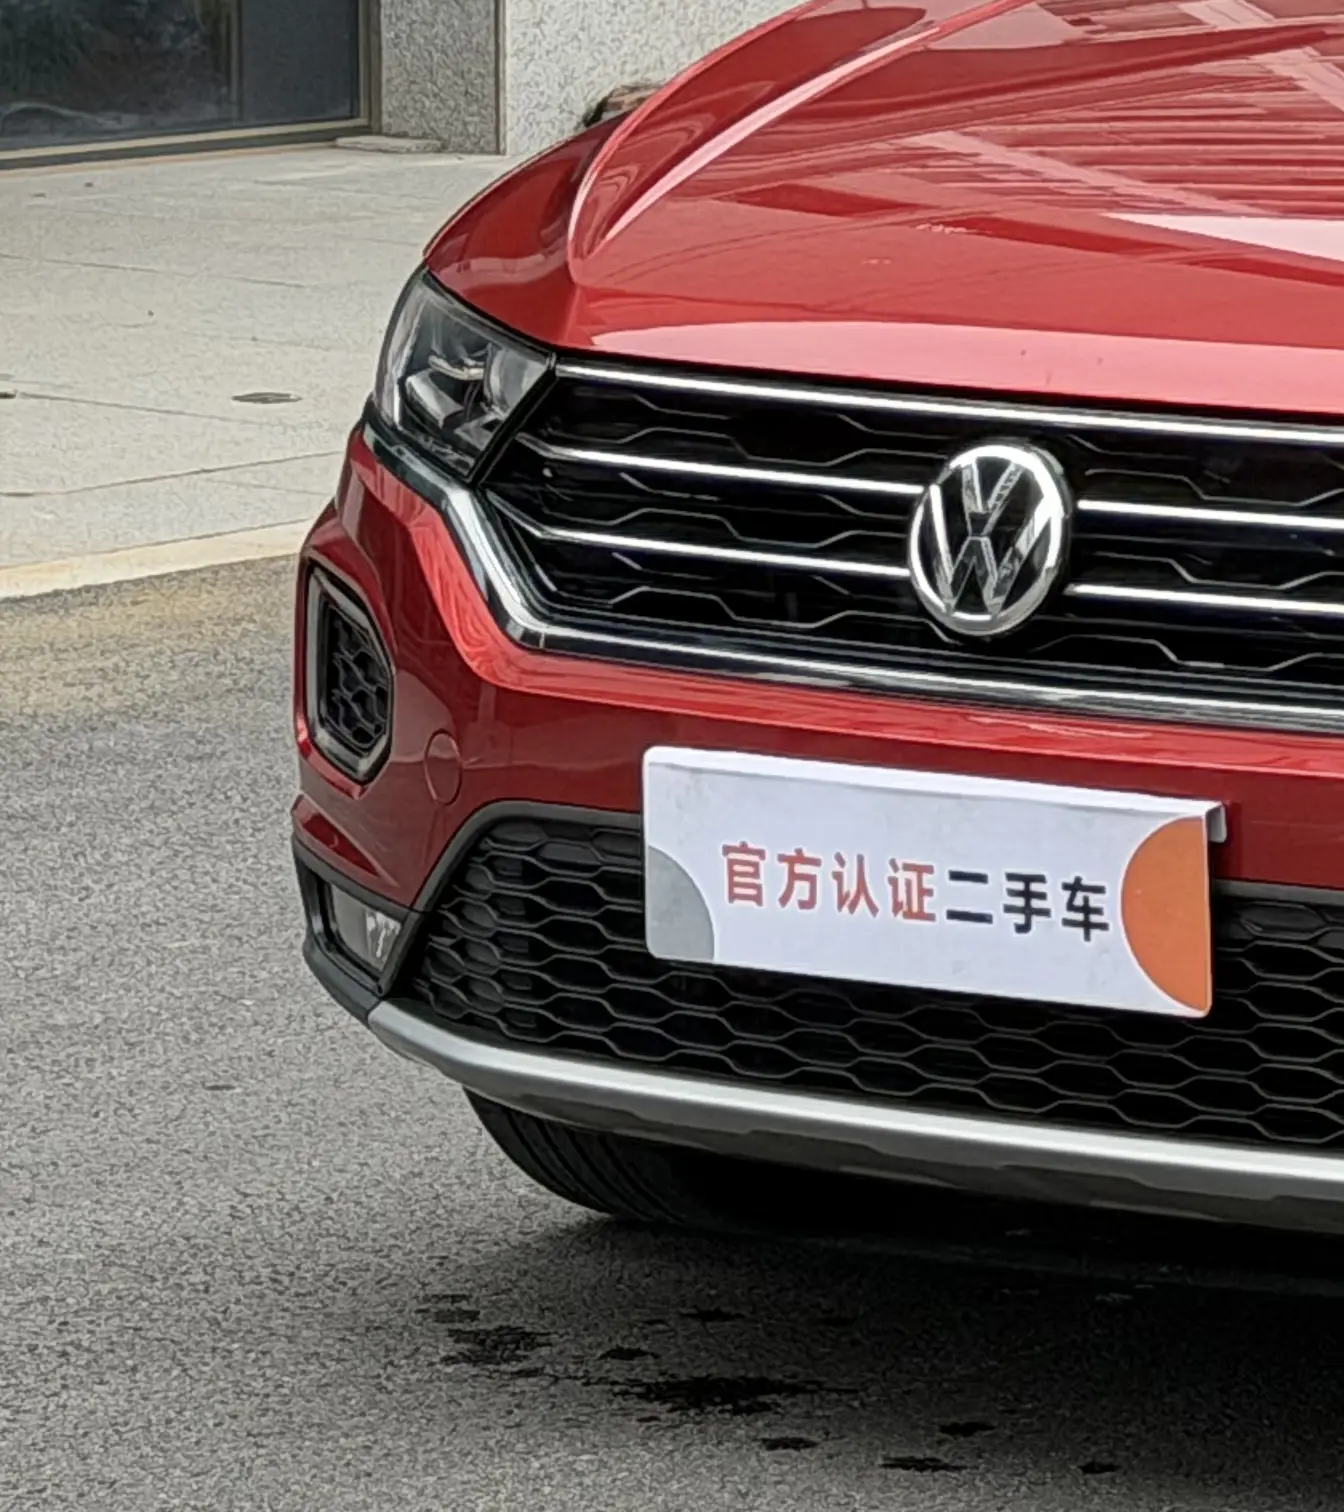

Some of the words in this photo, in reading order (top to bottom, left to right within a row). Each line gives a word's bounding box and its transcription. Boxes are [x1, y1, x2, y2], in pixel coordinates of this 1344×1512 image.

[720, 841, 1110, 943] 官方认证二手车
